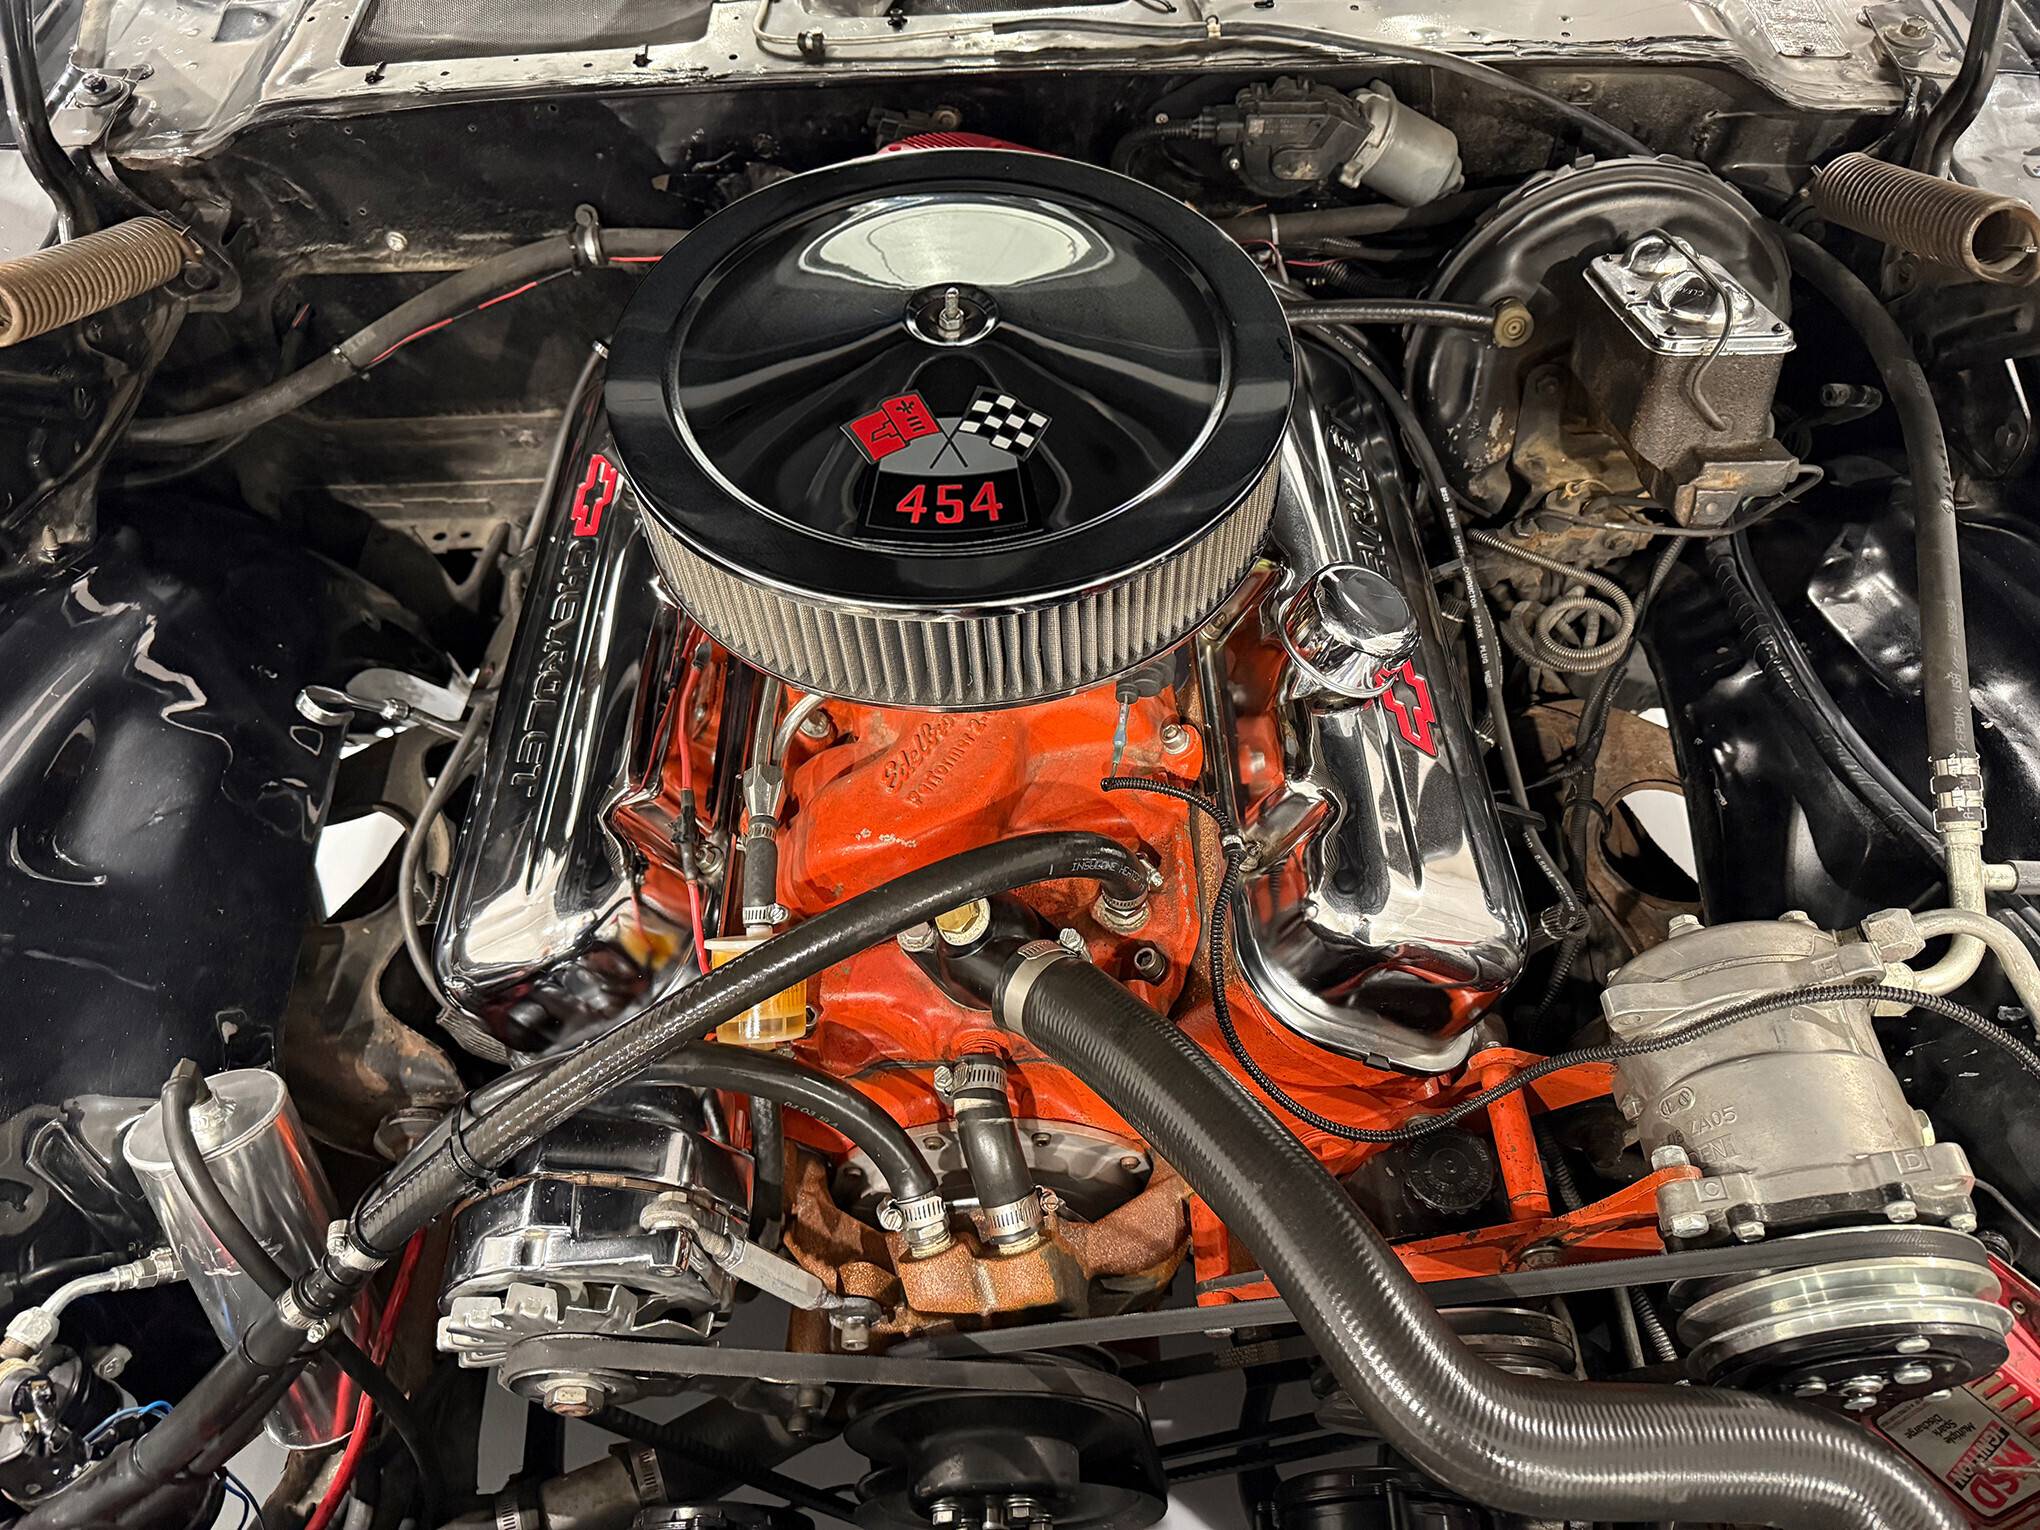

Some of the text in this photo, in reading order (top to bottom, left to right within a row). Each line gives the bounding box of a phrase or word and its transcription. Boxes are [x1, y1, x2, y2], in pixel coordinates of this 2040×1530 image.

[896, 481, 1003, 524] 454
[1326, 410, 1392, 579] EVROLET
[1462, 566, 1478, 609] CONDUCTOR
[1473, 615, 1484, 639] SPARK
[1479, 645, 1489, 665] PLUG
[511, 536, 599, 798] CHEVROLET
[1904, 1153, 1922, 1170] D
[1703, 1182, 1720, 1196] C
[1904, 1414, 1941, 1440] Discharge
[1931, 1416, 1958, 1437] Spark
[1943, 1421, 1977, 1444] Multiple
[1970, 1438, 2035, 1510] MSD
